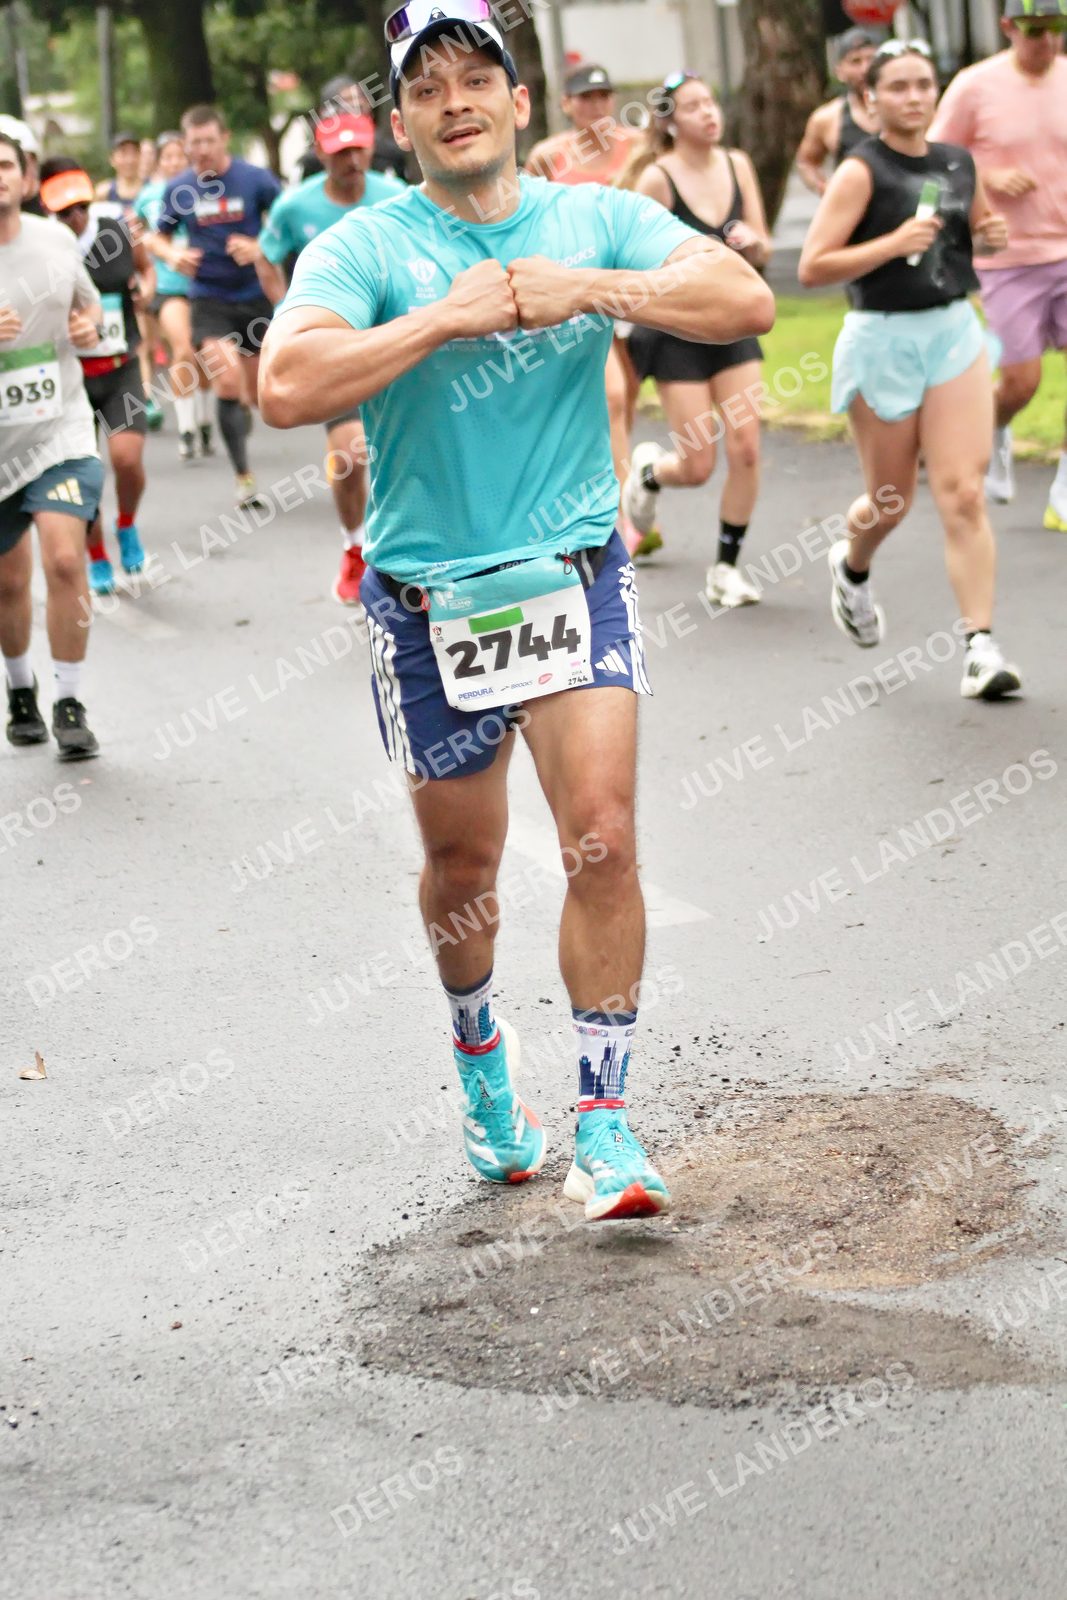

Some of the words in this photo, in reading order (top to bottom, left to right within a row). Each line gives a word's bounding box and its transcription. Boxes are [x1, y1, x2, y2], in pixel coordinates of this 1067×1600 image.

[556, 246, 597, 269] OOKS
[0, 378, 55, 409] 939
[445, 614, 581, 680] 2744
[568, 675, 588, 686] 2744
[458, 687, 494, 700] PERDURA
